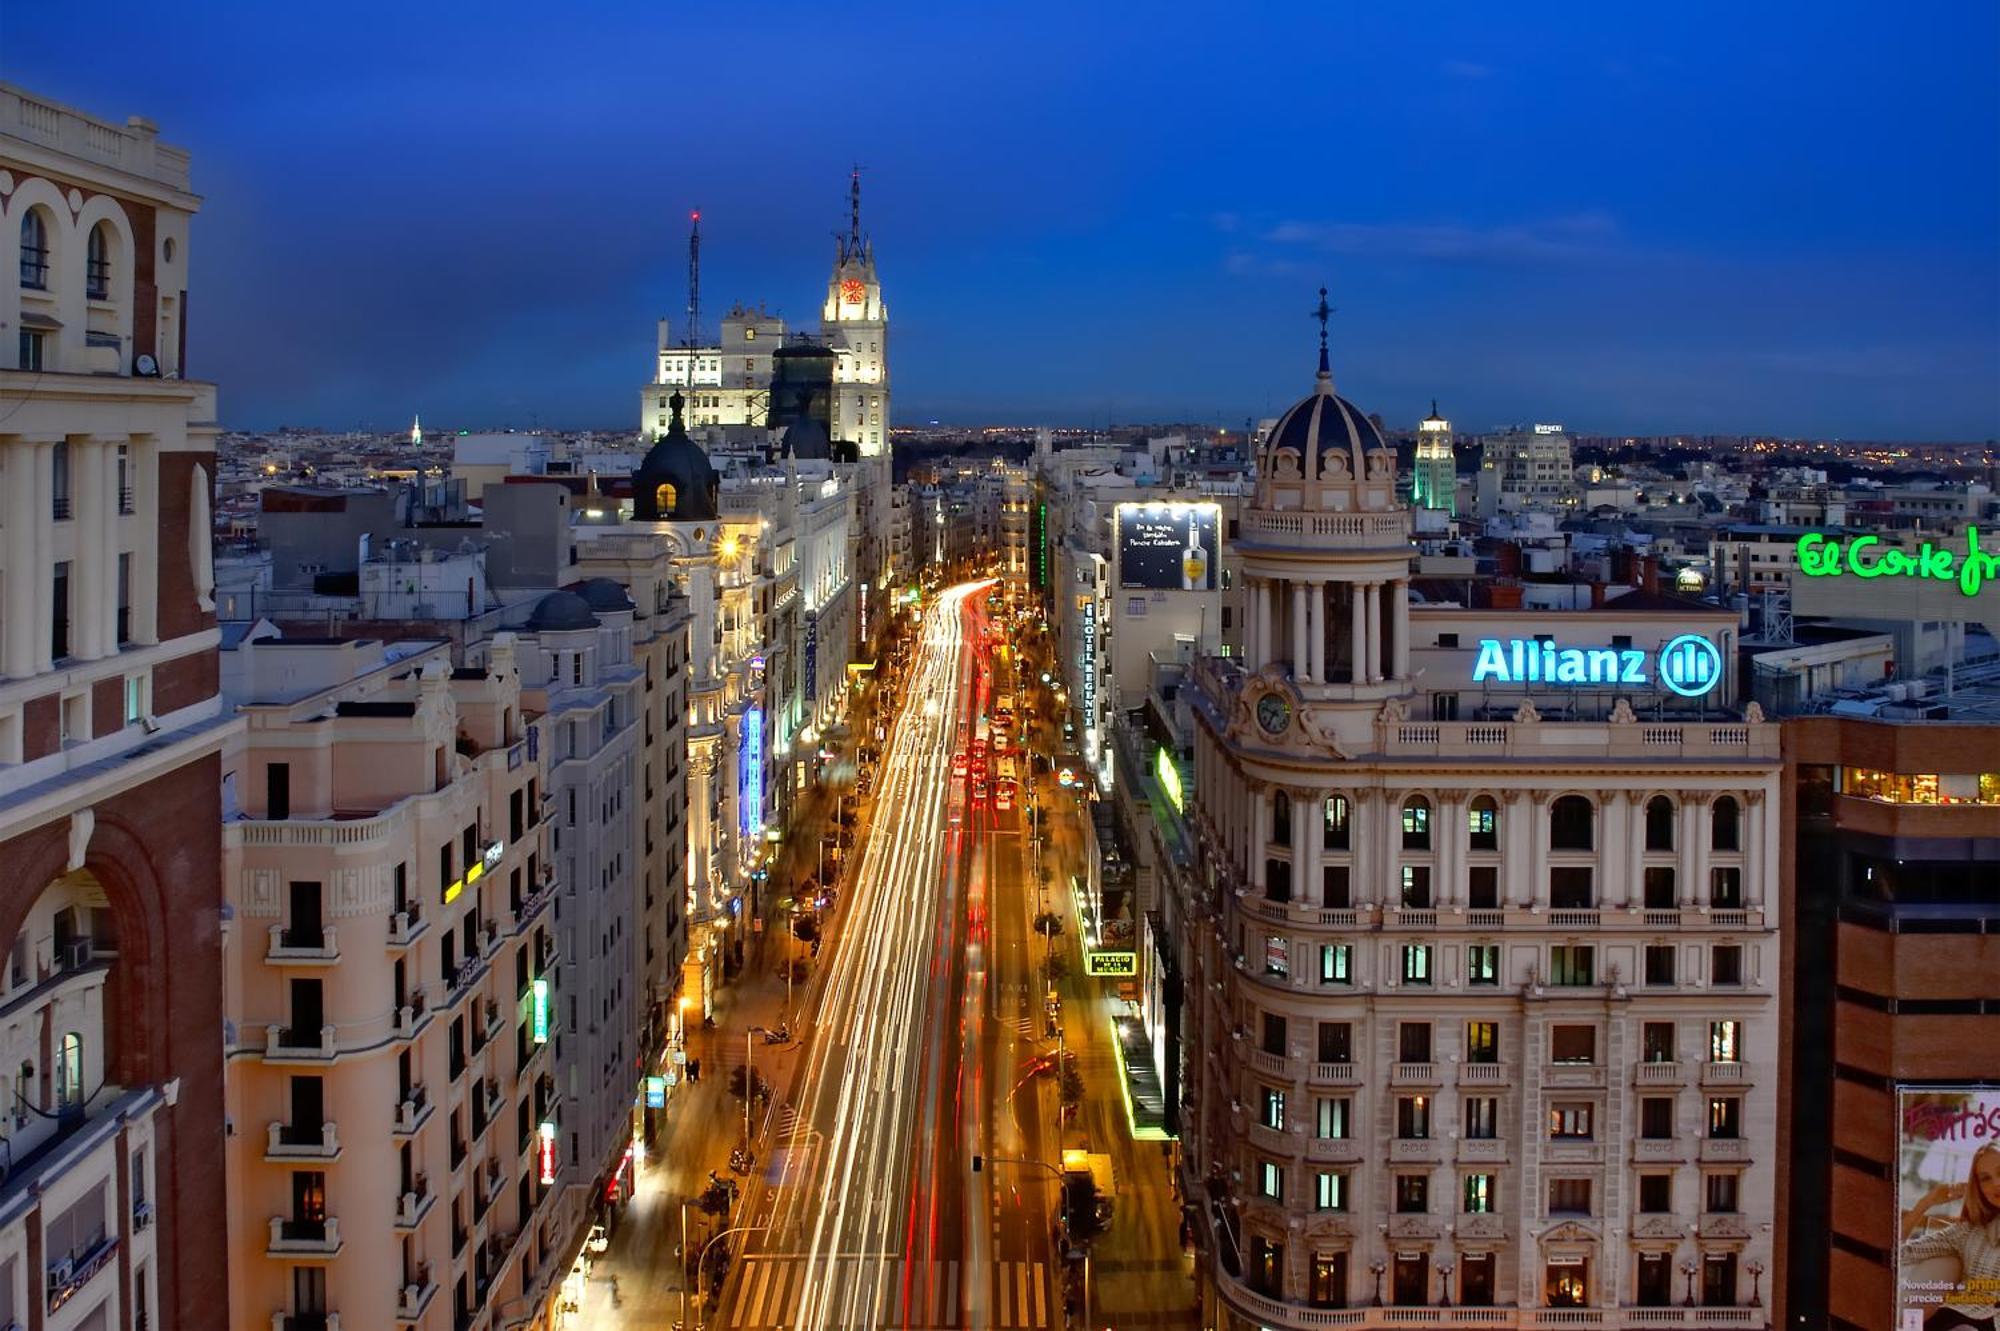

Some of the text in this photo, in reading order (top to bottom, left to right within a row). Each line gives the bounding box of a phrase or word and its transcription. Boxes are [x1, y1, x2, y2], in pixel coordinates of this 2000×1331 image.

[1797, 533, 1842, 576] El
[1847, 536, 1955, 580] Corte
[1084, 617, 1094, 661] HOTEL
[1473, 639, 1647, 683] Allianz
[1084, 664, 1094, 726] REGENTE
[1903, 1280, 1954, 1290] Novedades
[1908, 1293, 1943, 1304] precios
